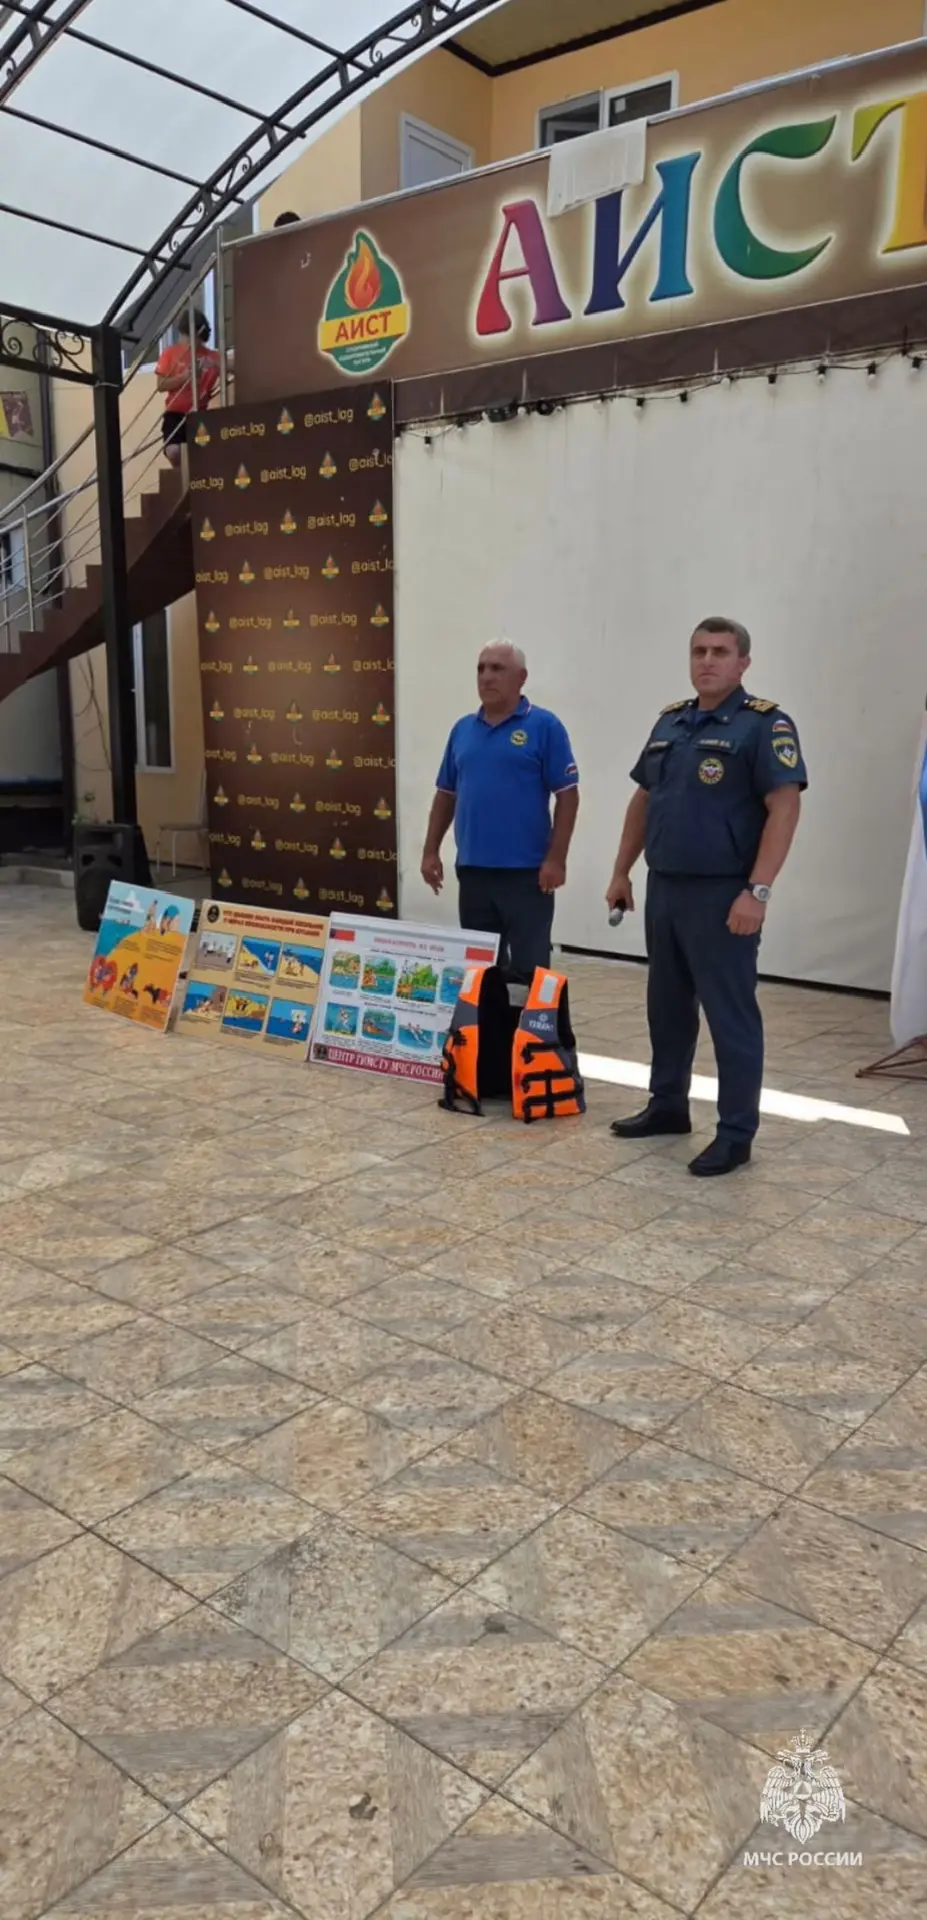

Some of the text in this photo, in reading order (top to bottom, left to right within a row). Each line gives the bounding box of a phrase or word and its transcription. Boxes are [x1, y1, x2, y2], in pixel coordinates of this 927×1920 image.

[335, 311, 392, 342] АИСТ
[190, 476, 223, 489] aist_lag
[195, 570, 228, 583] aist_lag
[200, 660, 232, 673] aist_lag
[204, 749, 236, 761] aist_lag
[208, 833, 241, 845] aist_lag
